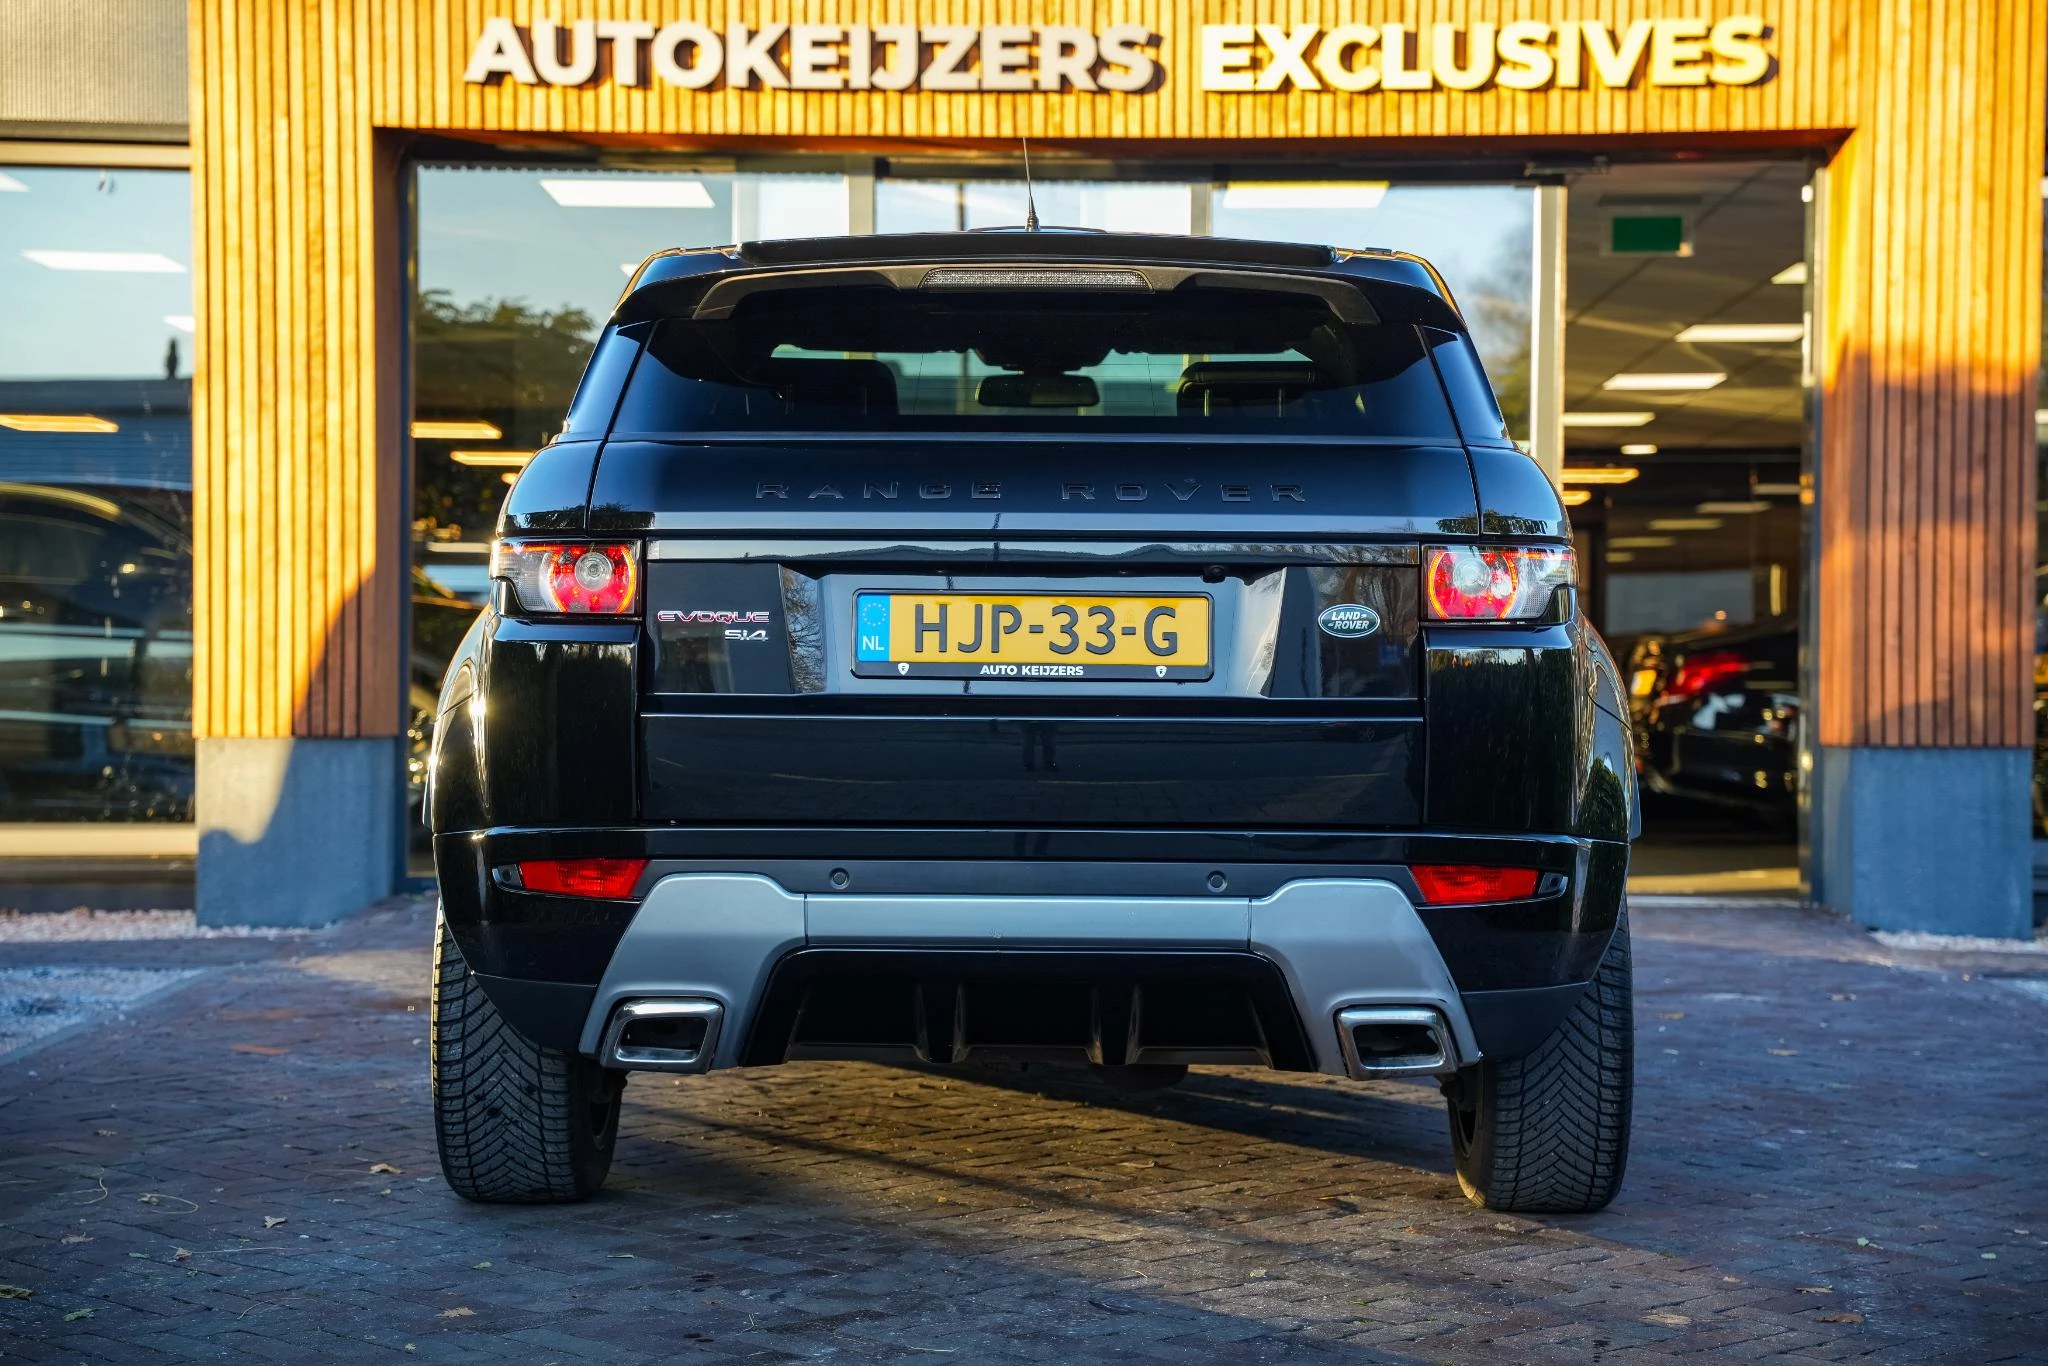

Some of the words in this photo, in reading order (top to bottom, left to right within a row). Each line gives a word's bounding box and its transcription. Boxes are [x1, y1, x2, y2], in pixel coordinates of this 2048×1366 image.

[464, 17, 1160, 92] AUTOKEIJZERS
[1200, 16, 1772, 92] EXCLUSIVES
[755, 481, 1001, 500] RANGE
[1060, 481, 1306, 502] ROVER
[657, 610, 770, 624] EVOQUE
[914, 603, 1178, 656] HJP-33-G
[862, 635, 885, 651] NL
[980, 665, 1018, 675] AUTO
[1021, 665, 1084, 676] KEIJZERS
